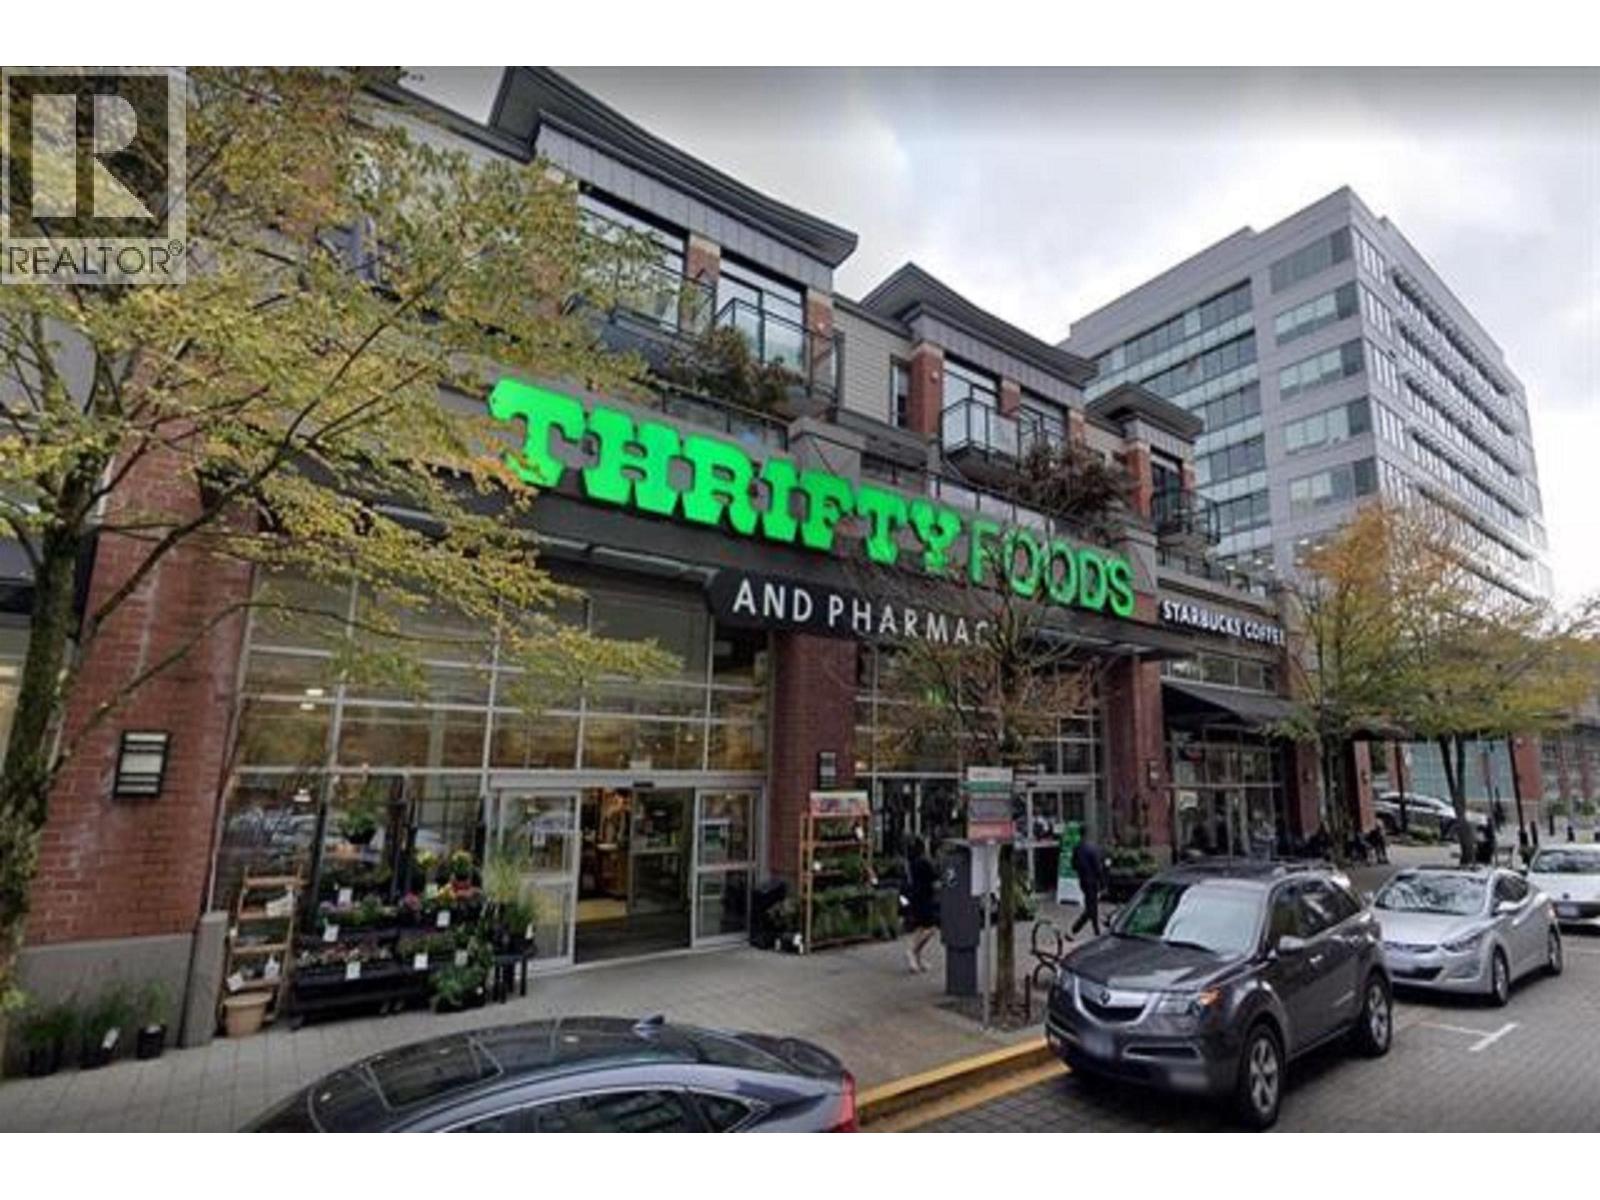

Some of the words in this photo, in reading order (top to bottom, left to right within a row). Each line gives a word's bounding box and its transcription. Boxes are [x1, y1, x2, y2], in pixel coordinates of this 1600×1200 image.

[488, 377, 961, 571] THRIFTY
[967, 518, 1135, 617] FOODS
[733, 578, 814, 622] AND
[827, 594, 1002, 648] PHARMAC
[1163, 600, 1242, 637] STARBUCKS
